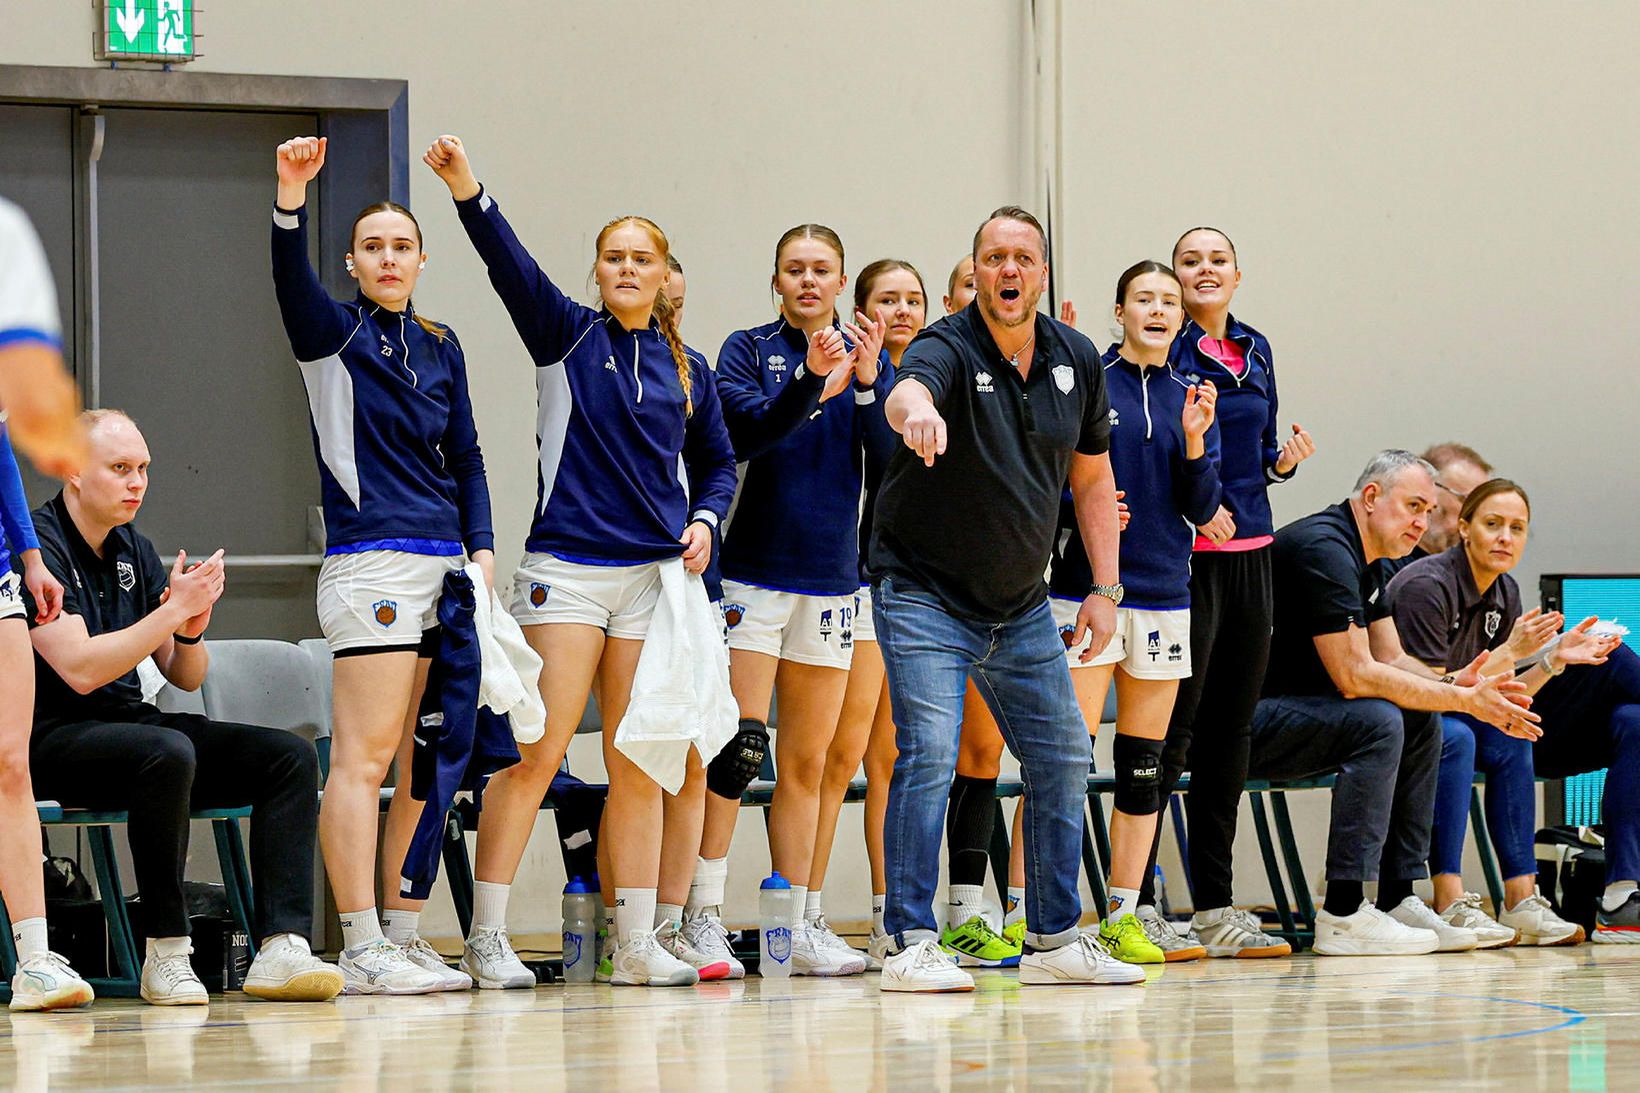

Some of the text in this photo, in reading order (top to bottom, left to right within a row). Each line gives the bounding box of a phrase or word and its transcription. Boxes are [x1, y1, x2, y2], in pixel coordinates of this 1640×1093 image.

[381, 345, 393, 357] 23
[776, 373, 782, 383] 1
[977, 385, 994, 393] errea
[840, 607, 852, 628] 19
[1133, 768, 1157, 776] SELECT
